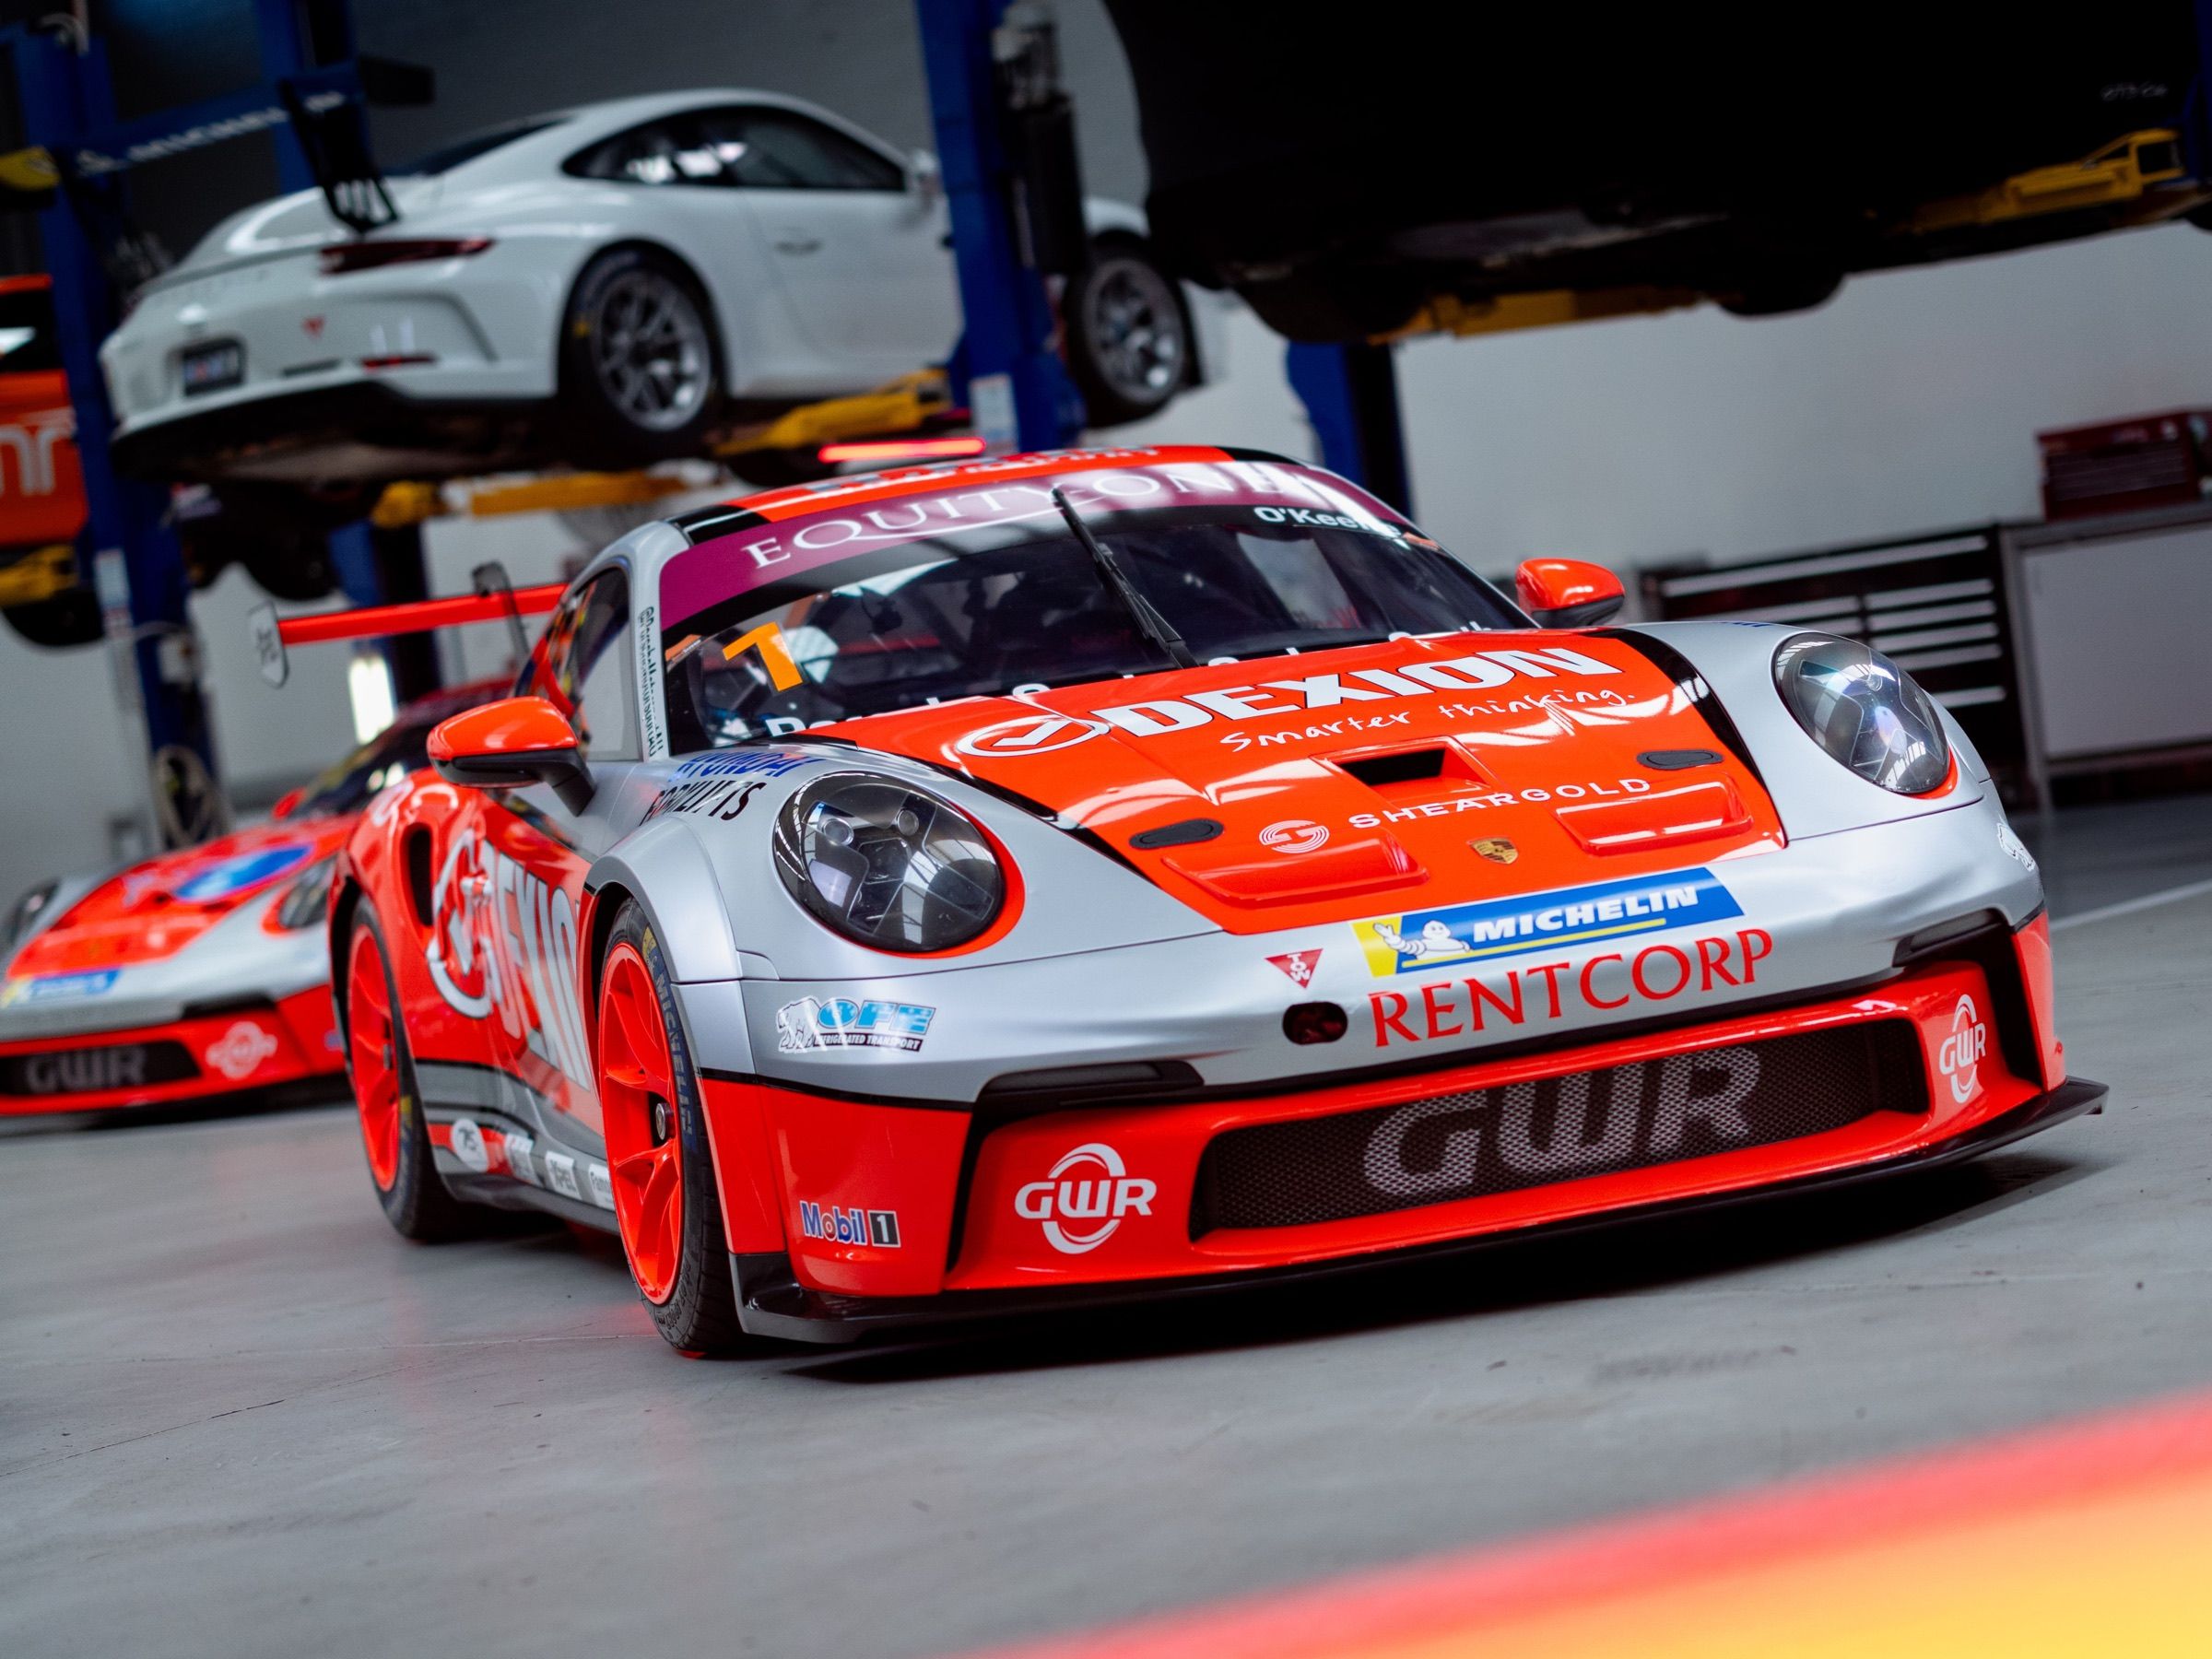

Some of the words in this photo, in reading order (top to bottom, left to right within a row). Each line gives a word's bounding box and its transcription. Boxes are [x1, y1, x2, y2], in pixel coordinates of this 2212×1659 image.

[1088, 647, 1626, 737] DEXION
[1219, 712, 1410, 753] Smarter
[1440, 689, 1636, 719] thinking.
[1348, 779, 1651, 829] SHEARGOLD
[1474, 886, 1698, 943] MICHELIN
[1287, 952, 1310, 982] TOW
[1368, 929, 1773, 1048] RENTCORP
[1363, 1046, 1760, 1197] GWR
[799, 1200, 868, 1246] Mobil
[1015, 1178, 1157, 1219] GWR
